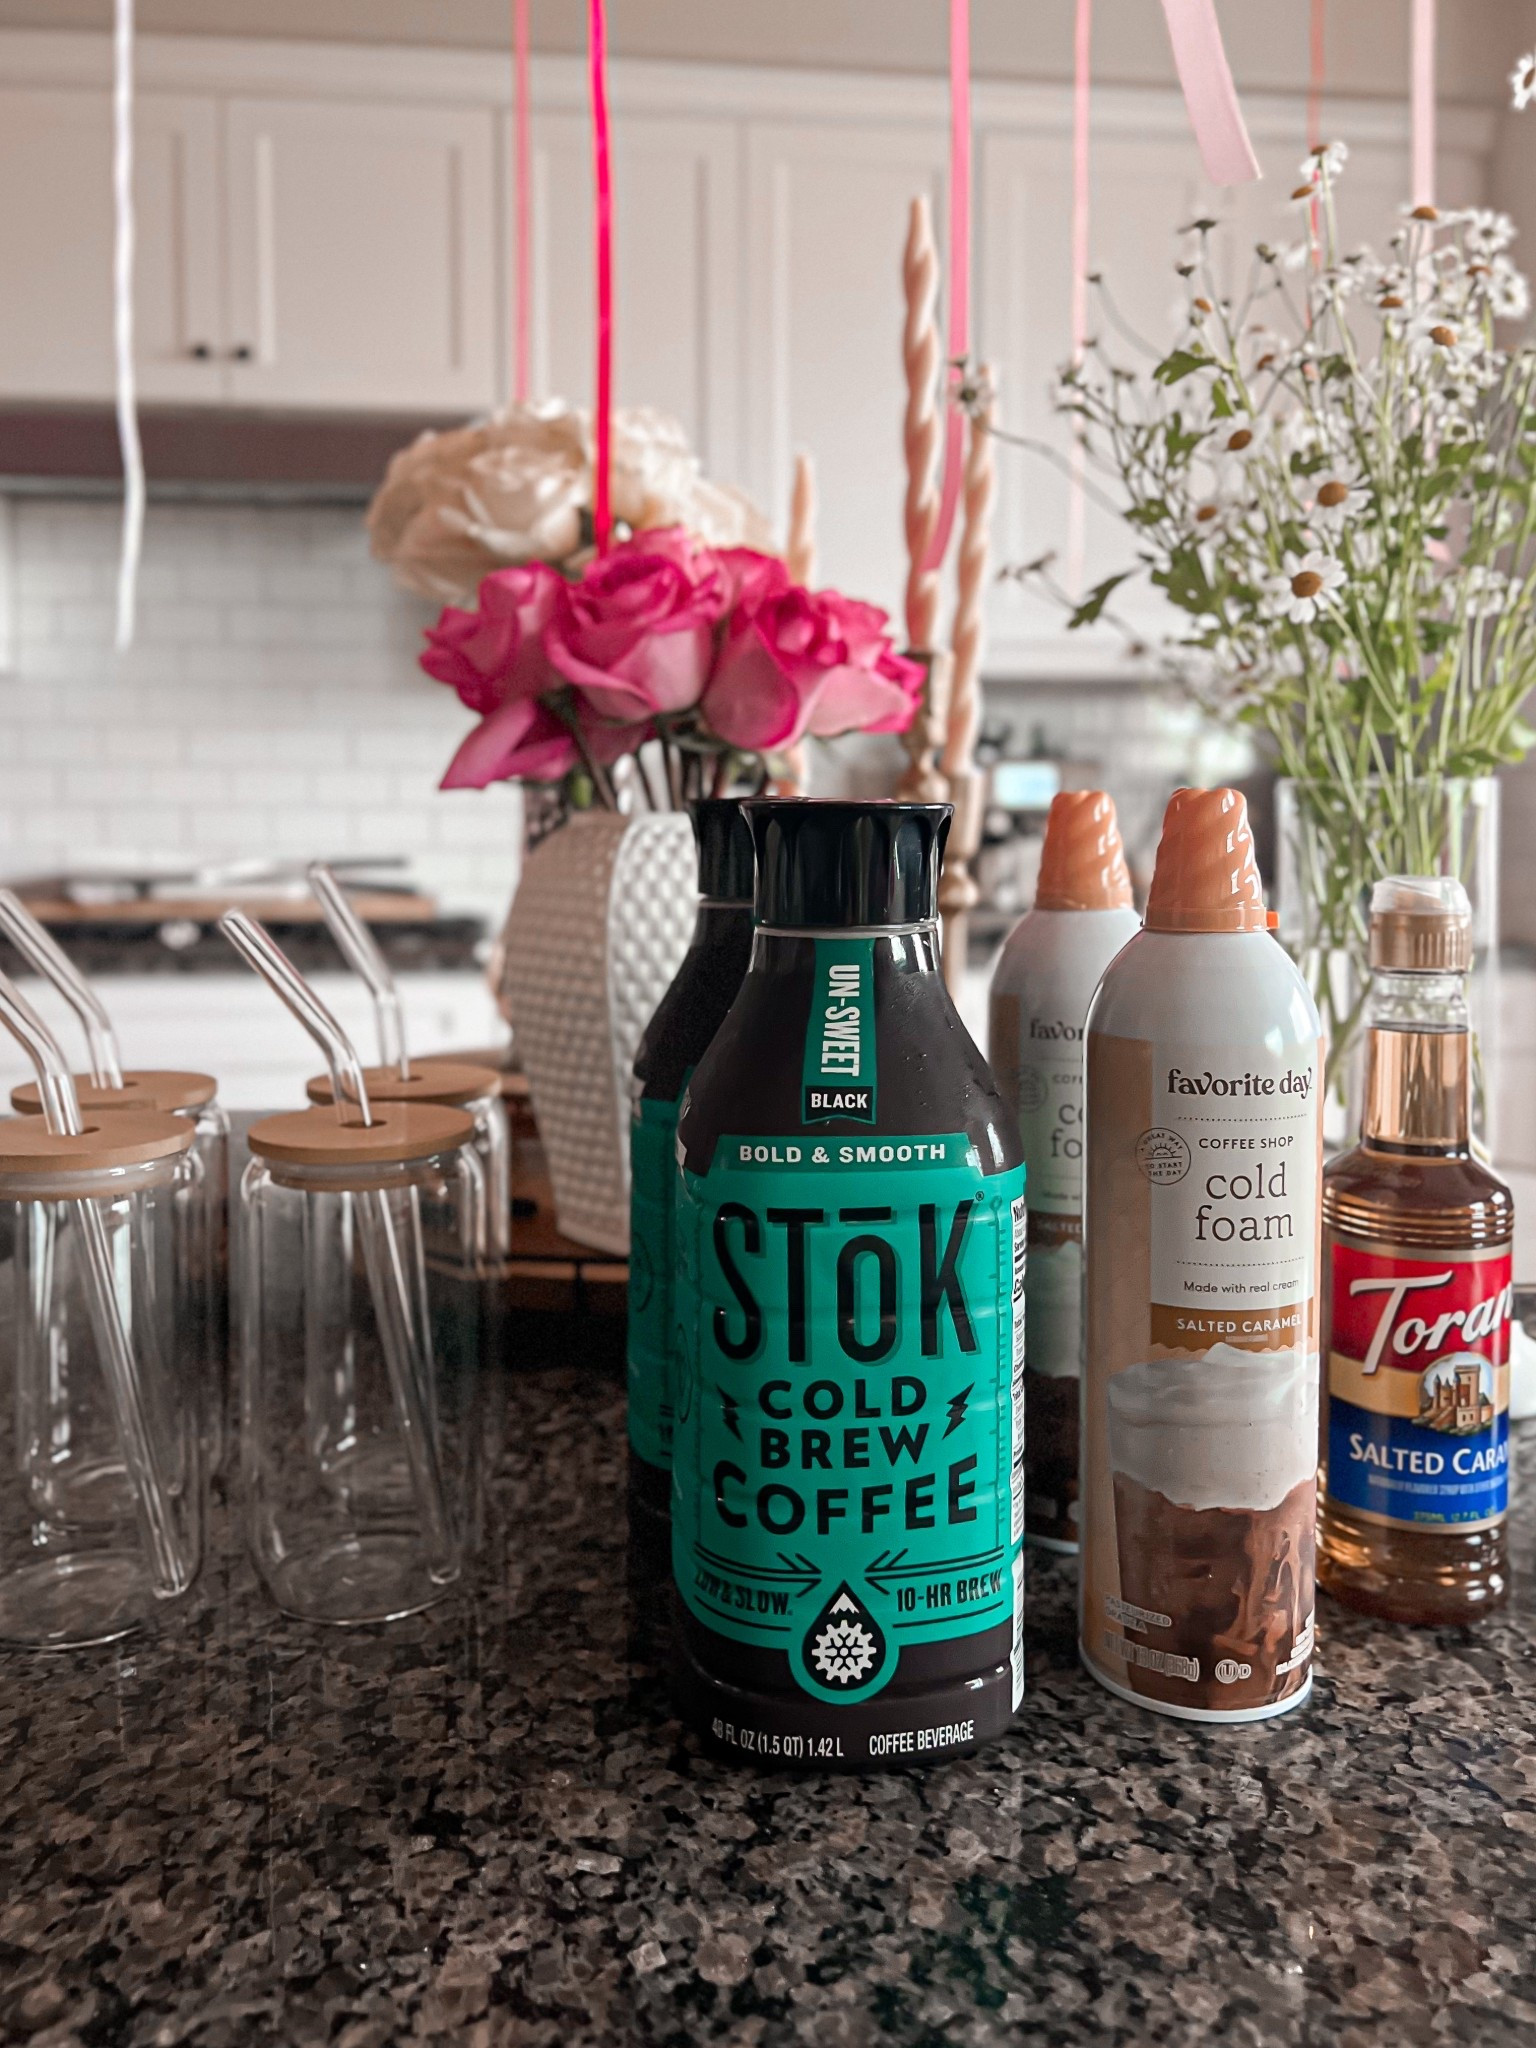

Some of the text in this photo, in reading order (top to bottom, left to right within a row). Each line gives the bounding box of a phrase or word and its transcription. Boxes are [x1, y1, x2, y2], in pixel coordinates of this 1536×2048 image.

[820, 964, 860, 1077] UN-SWEET
[810, 1092, 868, 1109] BLACK
[1168, 1066, 1312, 1100] favorite day
[739, 1143, 946, 1164] BOLD & SMOOTH
[1198, 1135, 1294, 1150] COFFEE SHOP
[1205, 1161, 1287, 1200] cold
[1194, 1204, 1294, 1242] foam
[1183, 1279, 1299, 1294] Made with real cream
[1176, 1313, 1302, 1333] SALTED CARAMEL
[758, 1375, 928, 1420] COLD
[759, 1422, 931, 1470] BREW
[1452, 1441, 1508, 1475] CARA
[713, 1453, 979, 1535] COFFEE
[896, 1567, 1003, 1613] 10-HR BREW
[725, 1722, 738, 1745] FL
[740, 1728, 755, 1750] OZ
[757, 1731, 780, 1755] (1.5
[783, 1735, 804, 1759] QT)
[807, 1737, 833, 1757] 1.42
[836, 1737, 844, 1757] L
[869, 1719, 975, 1756] COFFEE BEVERAGE
